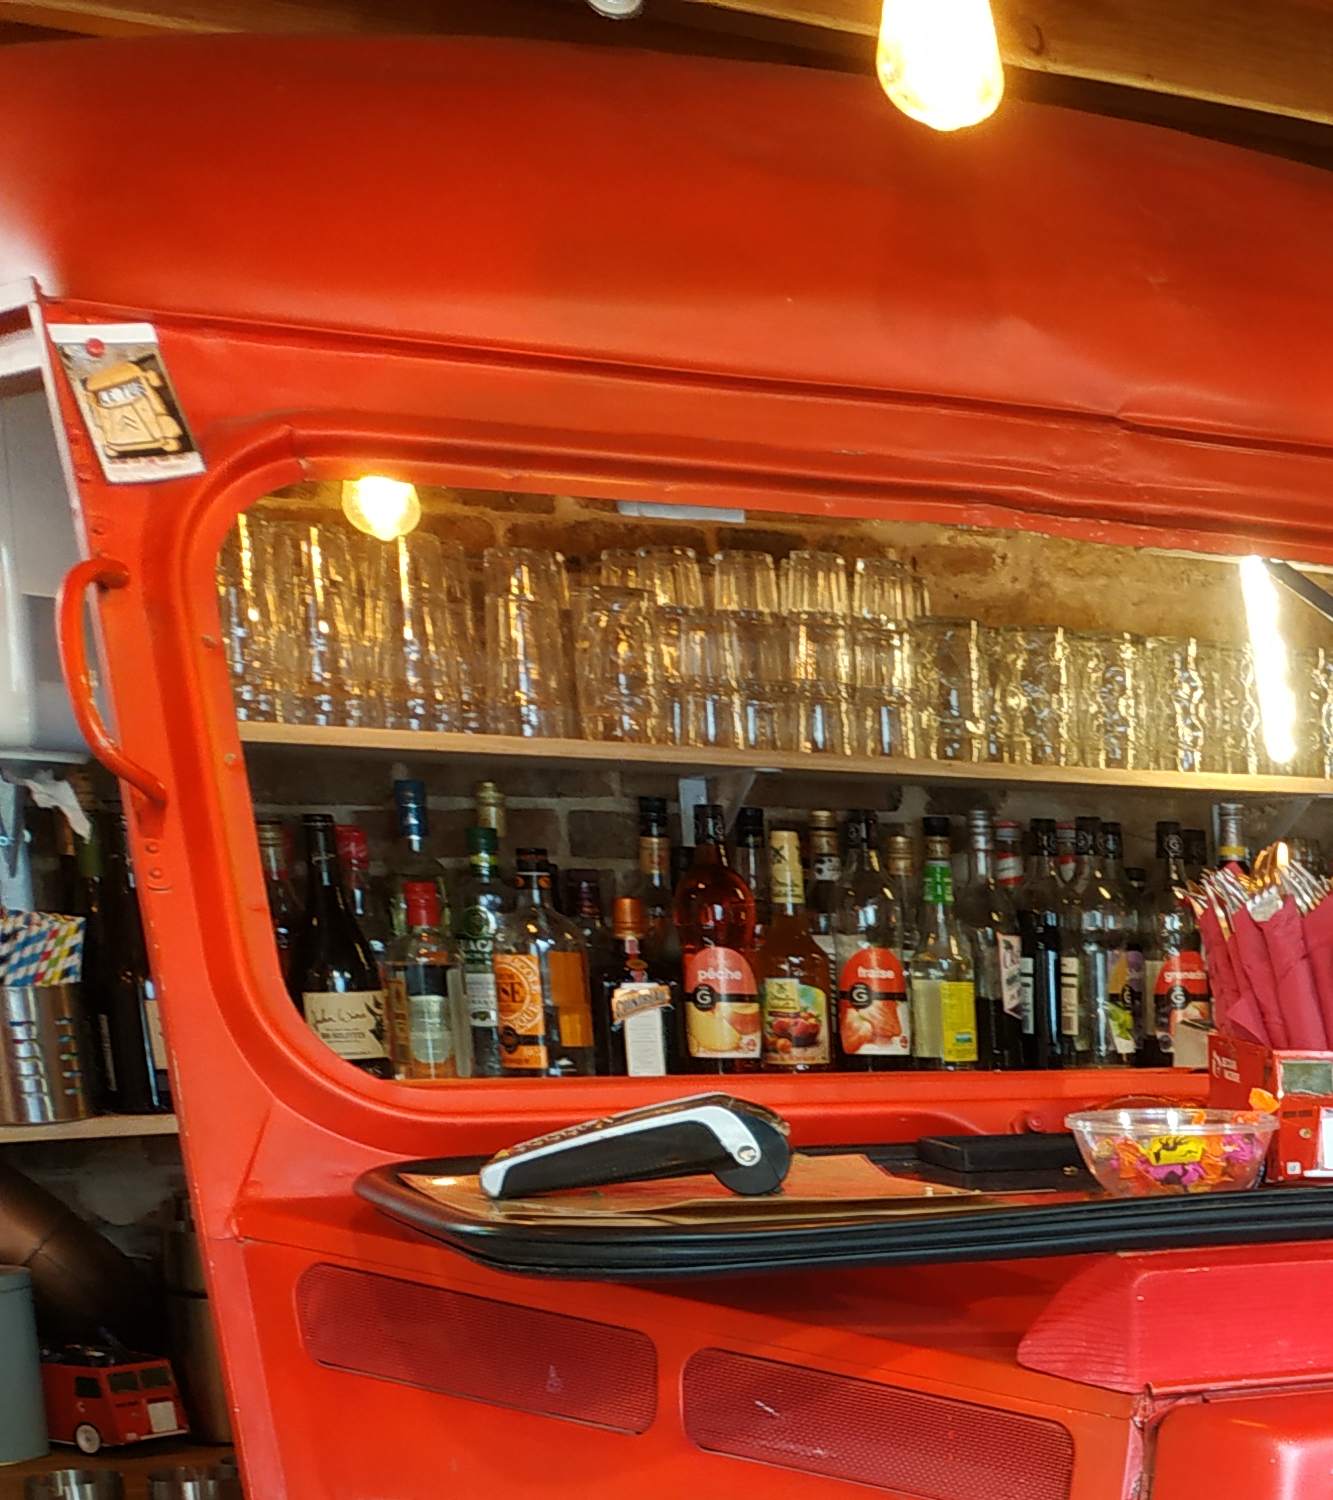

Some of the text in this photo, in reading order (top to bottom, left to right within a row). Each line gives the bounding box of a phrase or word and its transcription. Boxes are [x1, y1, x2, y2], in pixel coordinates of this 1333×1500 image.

[697, 967, 742, 983] pêche
[857, 966, 895, 979] fraise
[696, 990, 712, 1004] G
[851, 988, 869, 1002] G
